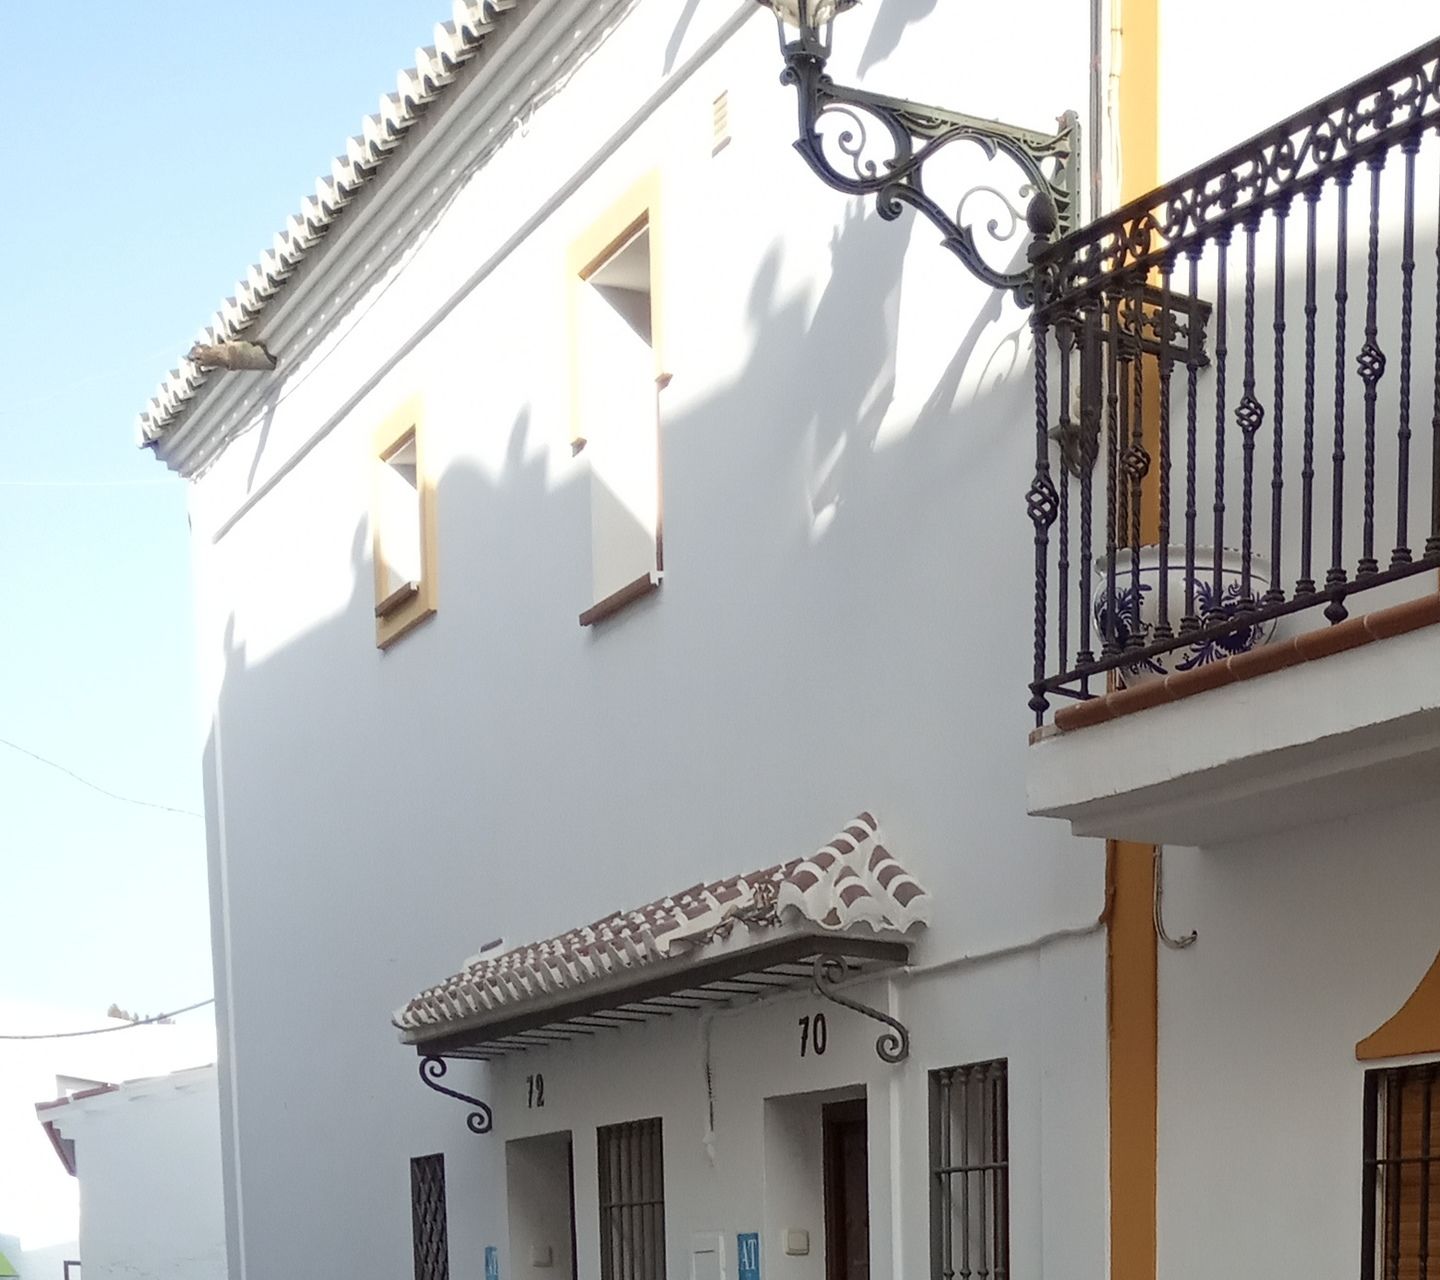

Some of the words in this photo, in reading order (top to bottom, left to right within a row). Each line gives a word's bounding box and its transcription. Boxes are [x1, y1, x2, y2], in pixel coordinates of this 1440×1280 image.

[798, 1012, 827, 1058] 70
[526, 1073, 545, 1110] 72
[741, 1238, 758, 1271] AT
